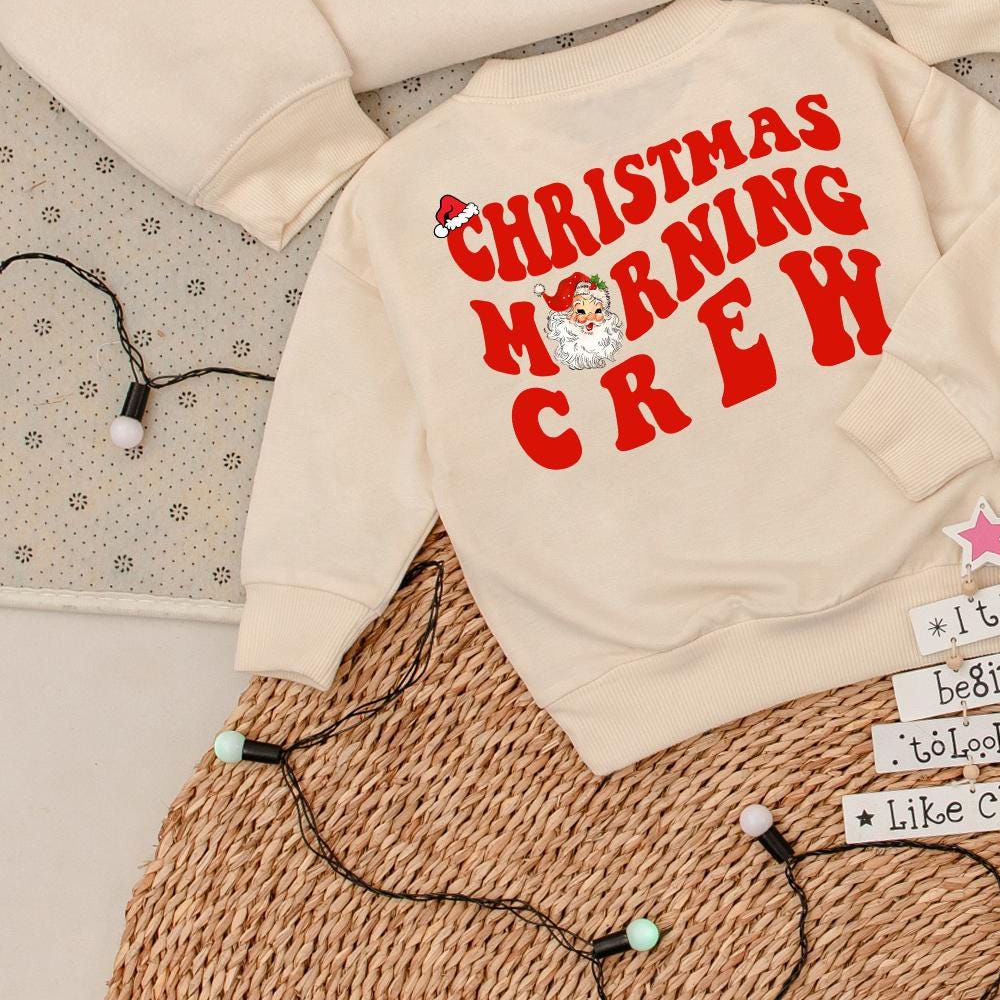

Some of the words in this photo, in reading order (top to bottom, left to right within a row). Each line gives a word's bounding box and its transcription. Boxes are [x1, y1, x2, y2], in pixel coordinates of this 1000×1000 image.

[447, 93, 841, 282] CHRISTMAS
[469, 164, 869, 377] MRNING
[511, 245, 893, 470] CREW
[887, 796, 964, 831] Like
